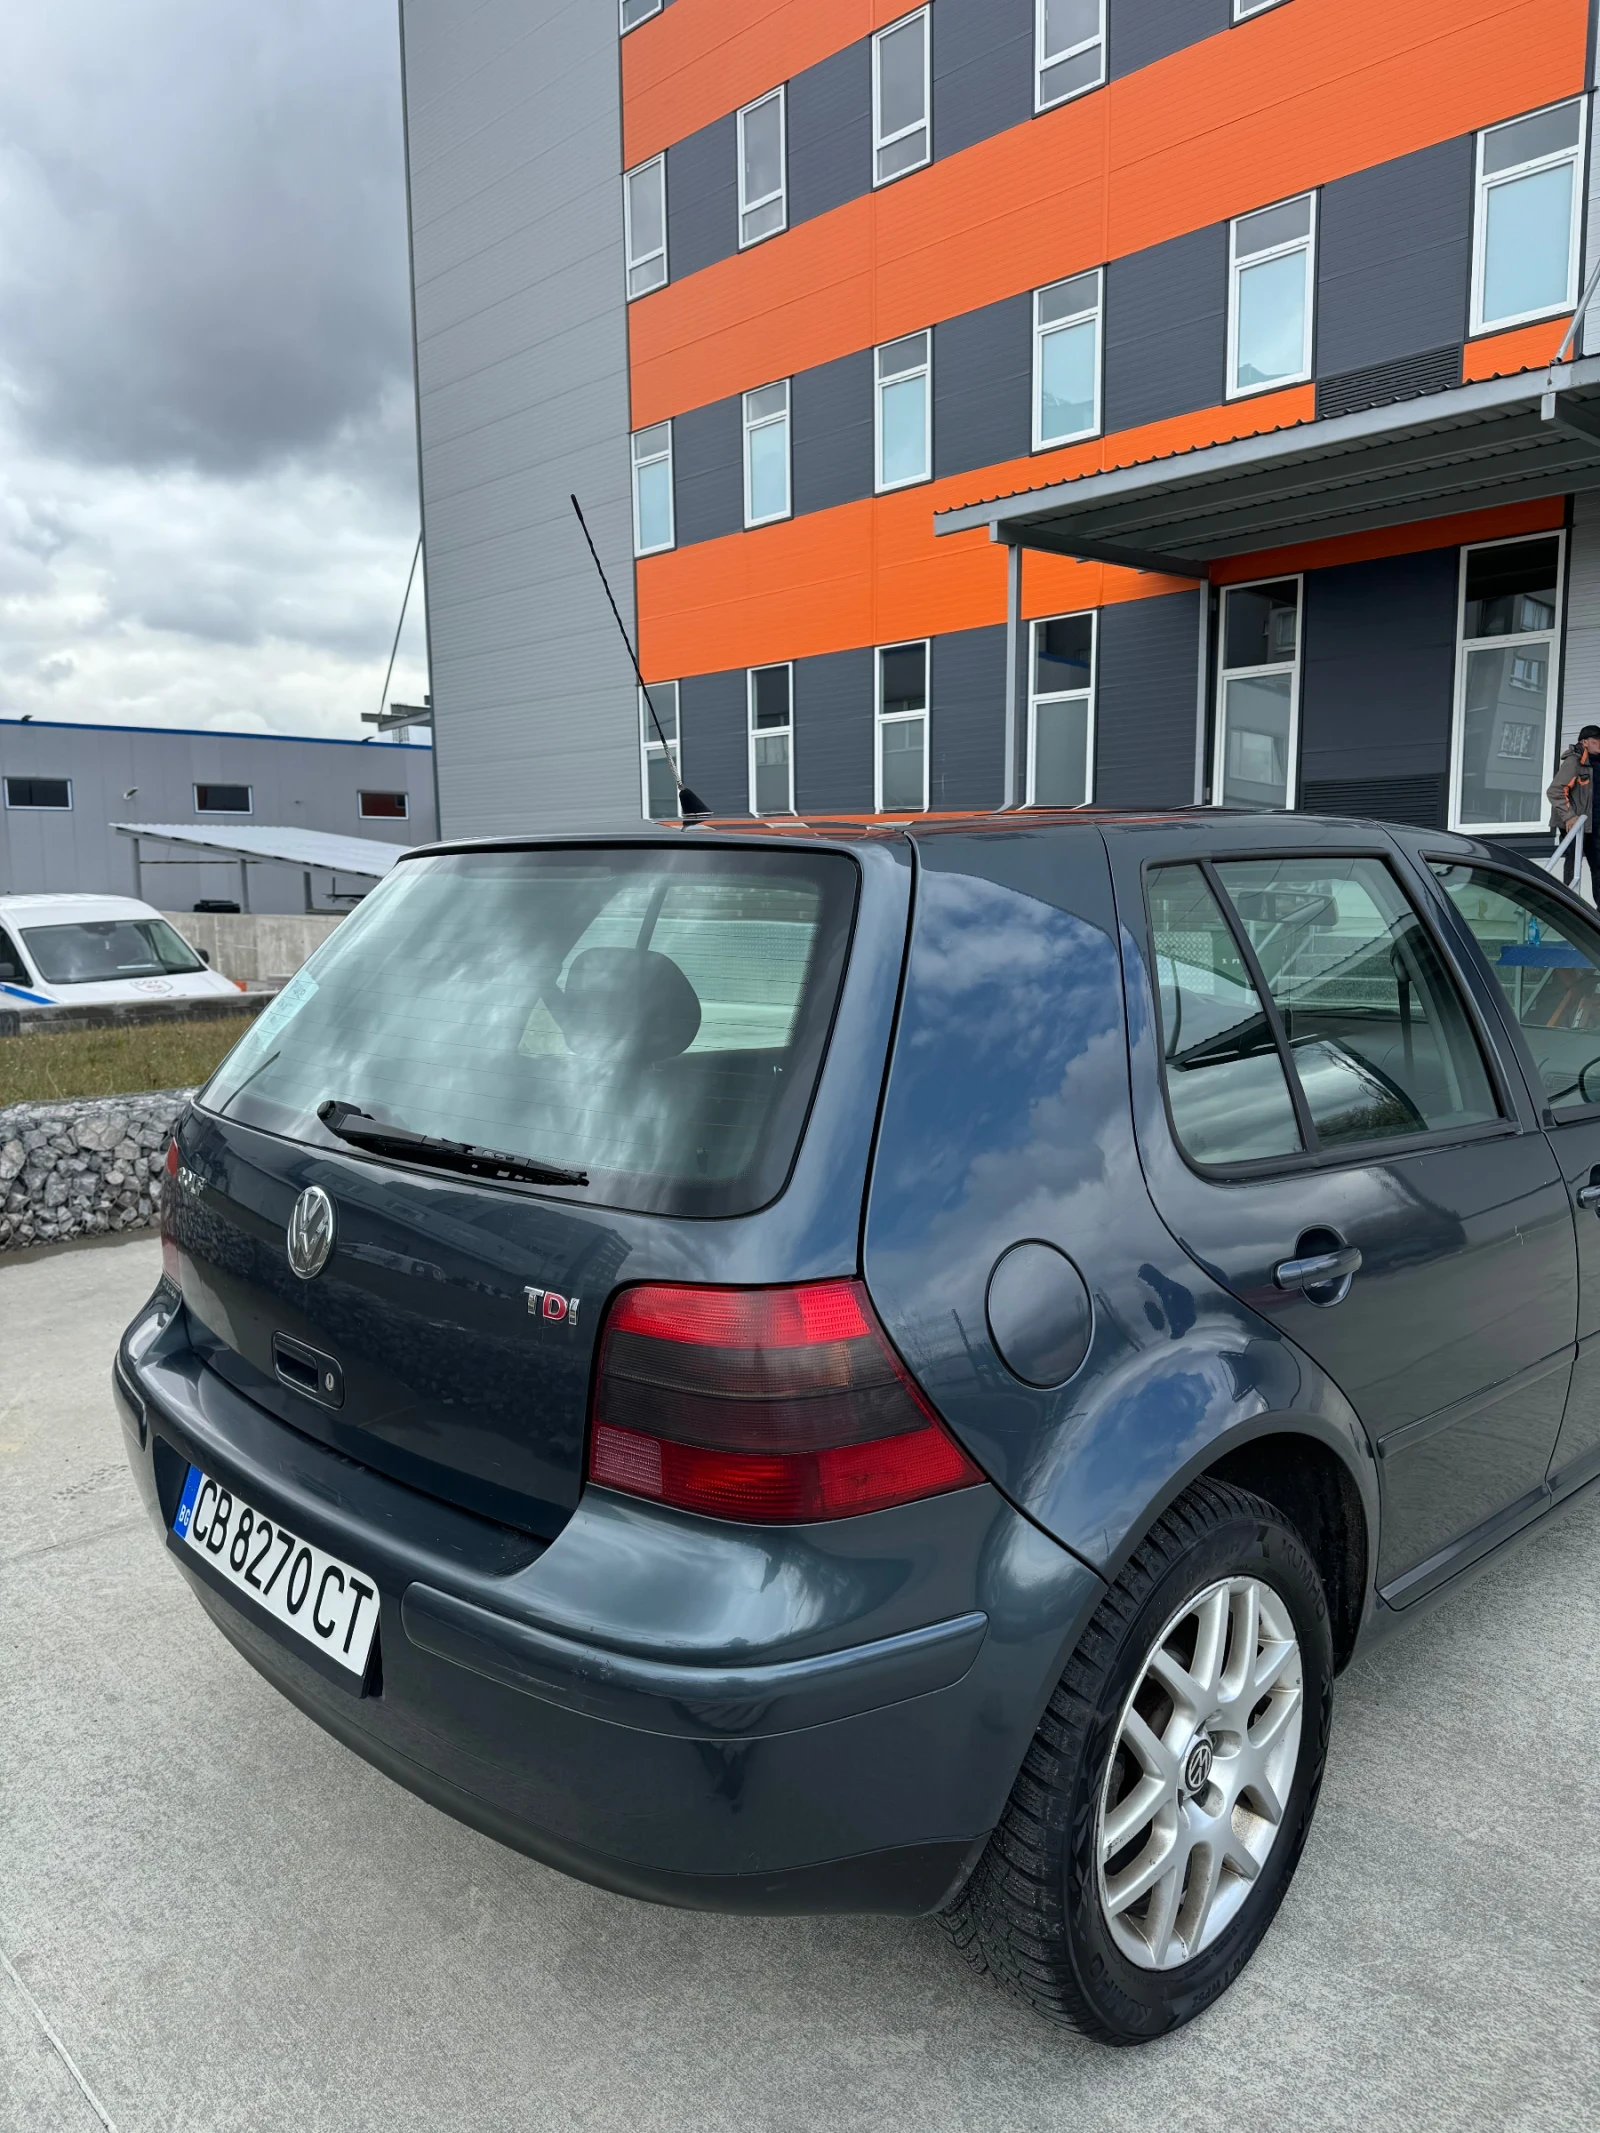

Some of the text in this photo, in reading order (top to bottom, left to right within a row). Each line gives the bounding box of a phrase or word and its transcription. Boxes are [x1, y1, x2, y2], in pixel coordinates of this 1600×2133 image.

[523, 1285, 580, 1326] TDI
[178, 1504, 191, 1527] BG
[1284, 1539, 1326, 1623] KUMHO
[1090, 1951, 1152, 2030] KUMHO
